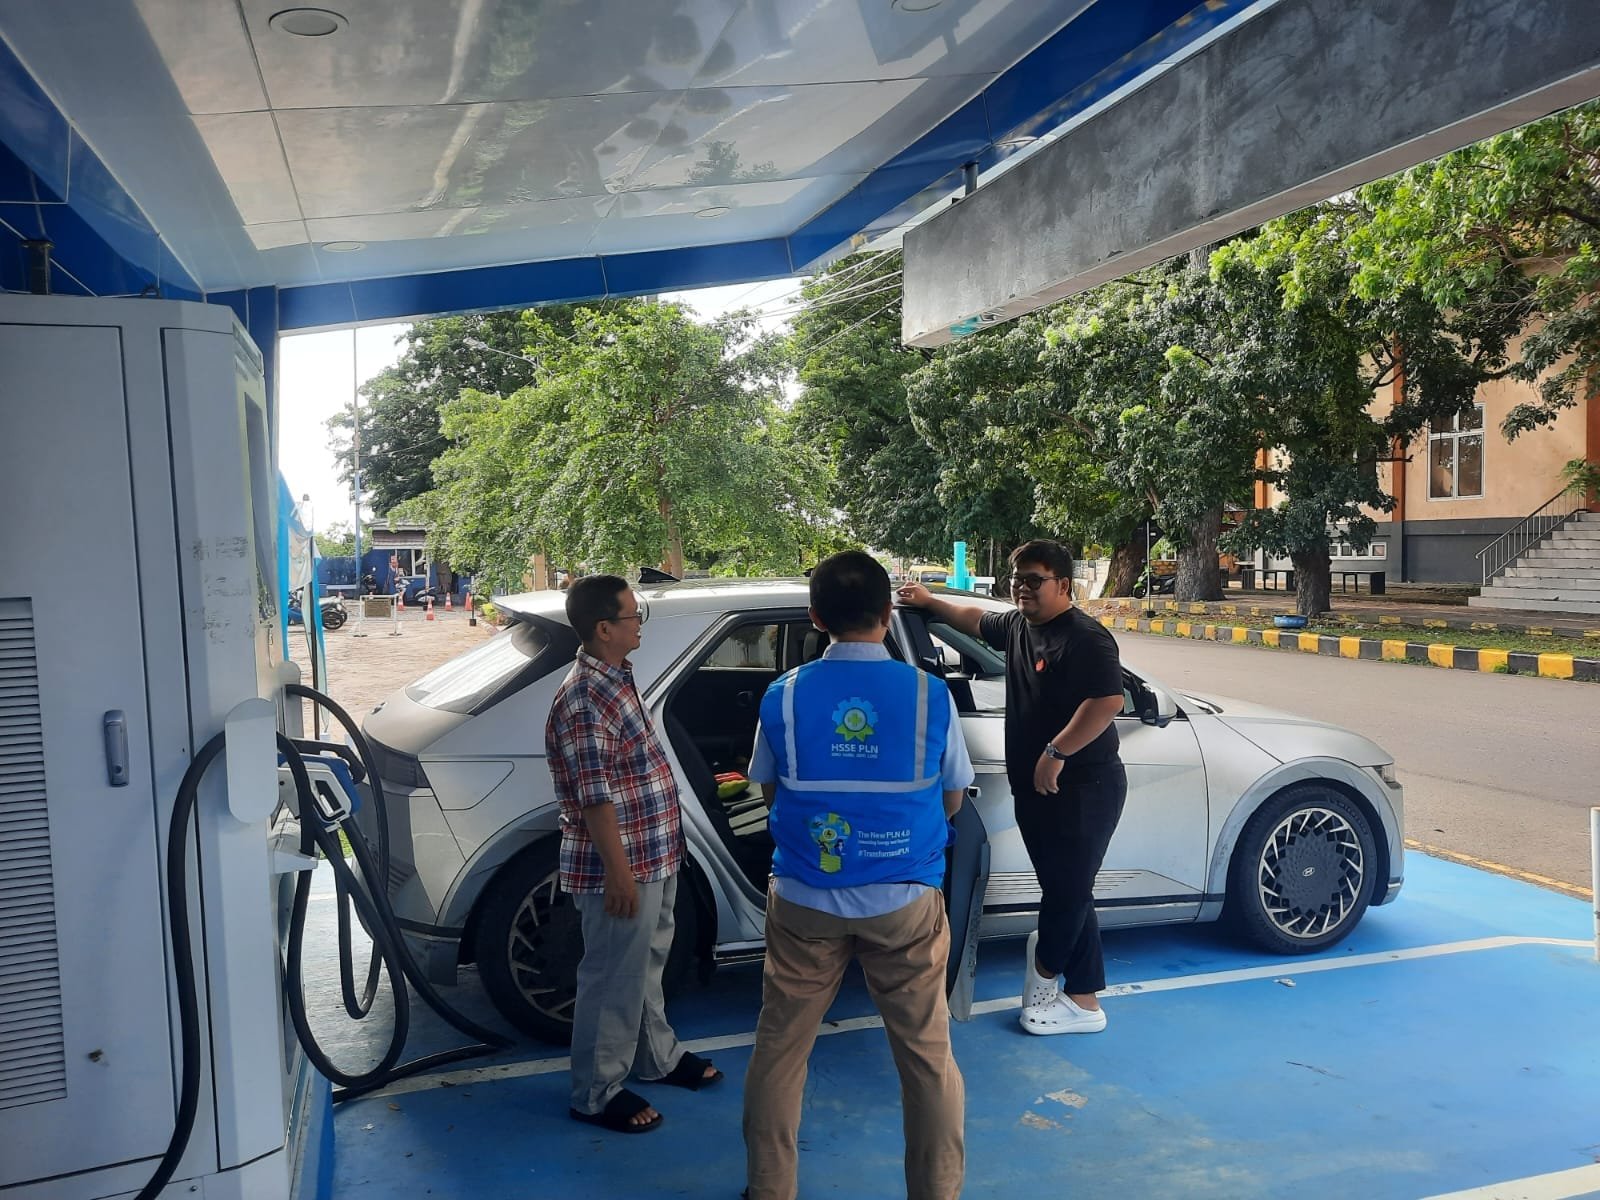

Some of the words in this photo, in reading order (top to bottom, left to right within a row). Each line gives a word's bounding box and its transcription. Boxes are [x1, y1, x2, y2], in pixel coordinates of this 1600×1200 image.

[831, 743, 857, 752] HSSE
[858, 744, 879, 754] PLN
[857, 830, 869, 839] The
[870, 831, 886, 839] New
[886, 831, 901, 839] PLN
